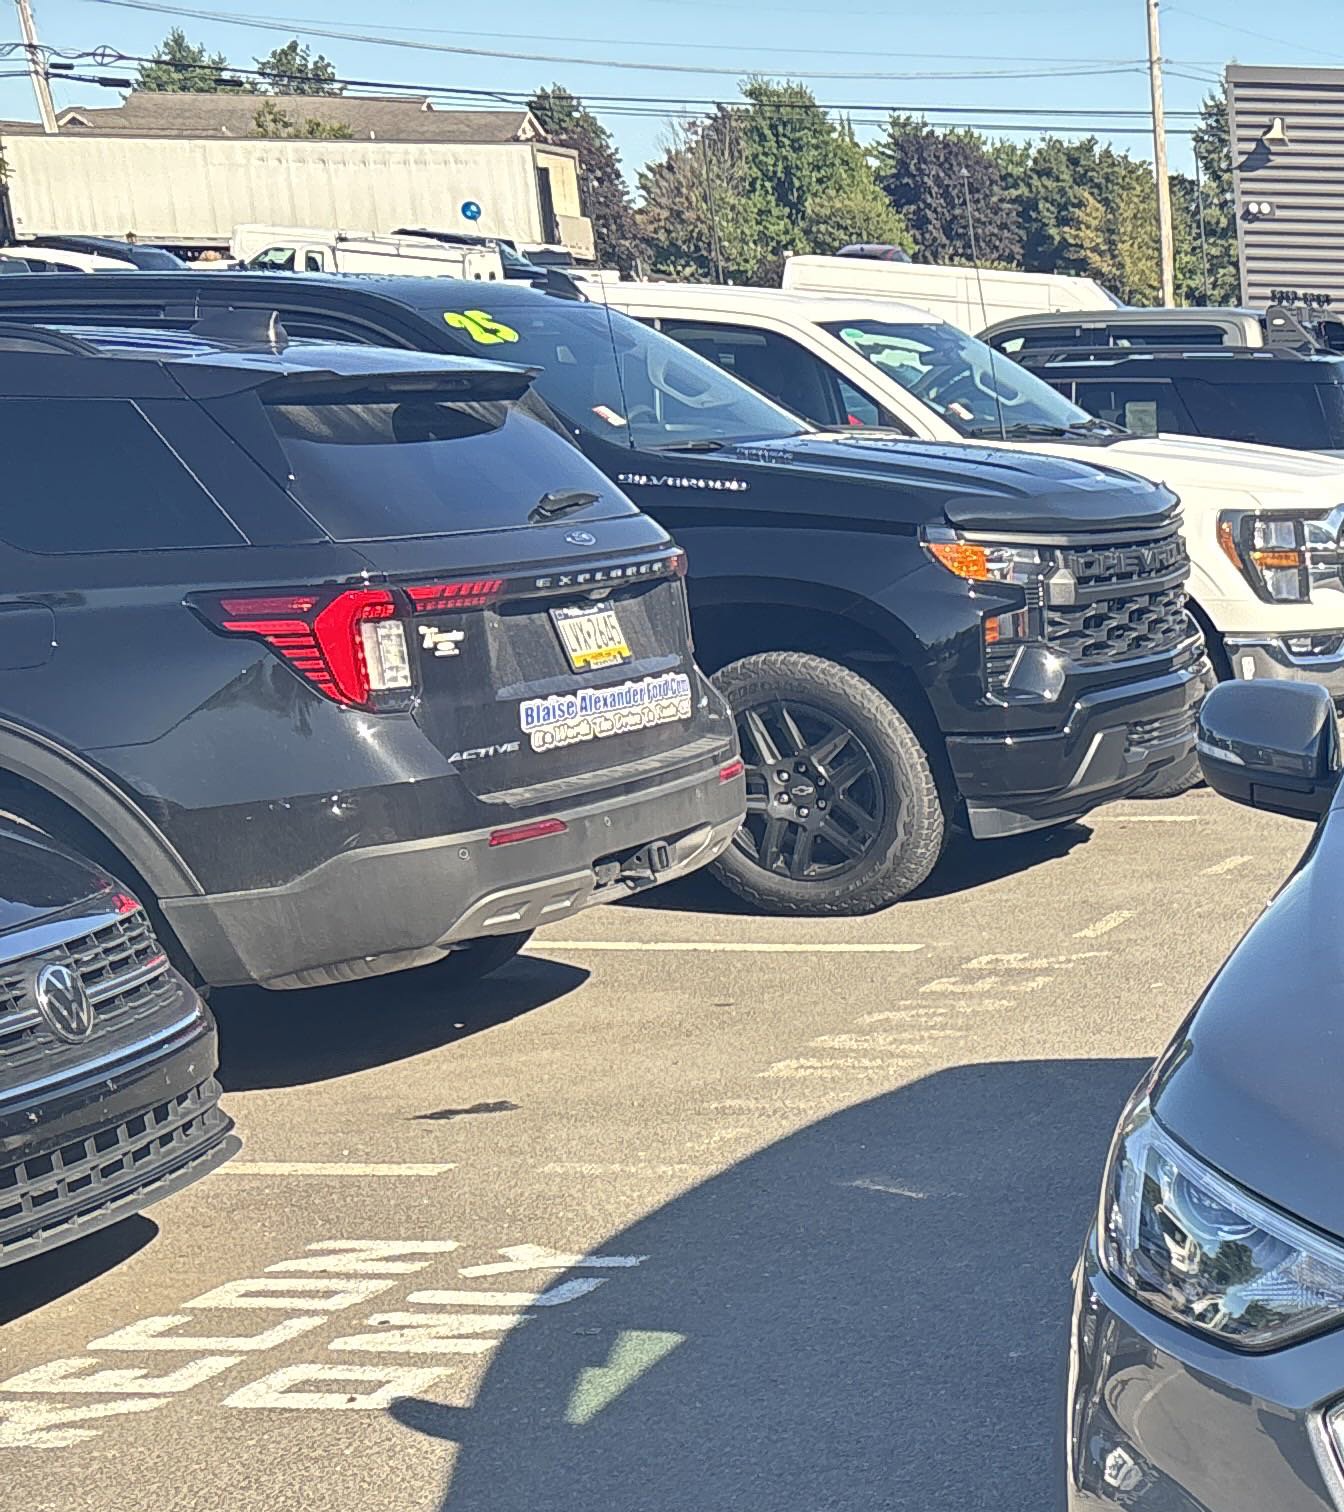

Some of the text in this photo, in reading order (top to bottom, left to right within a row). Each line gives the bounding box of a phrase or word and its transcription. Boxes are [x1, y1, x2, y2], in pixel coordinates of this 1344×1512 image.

[535, 561, 663, 588] EXPLORER
[525, 701, 577, 726] Blaise
[579, 687, 646, 713] Alexander
[448, 741, 521, 763] ACTIVE
[221, 1244, 650, 1410] ONLY
